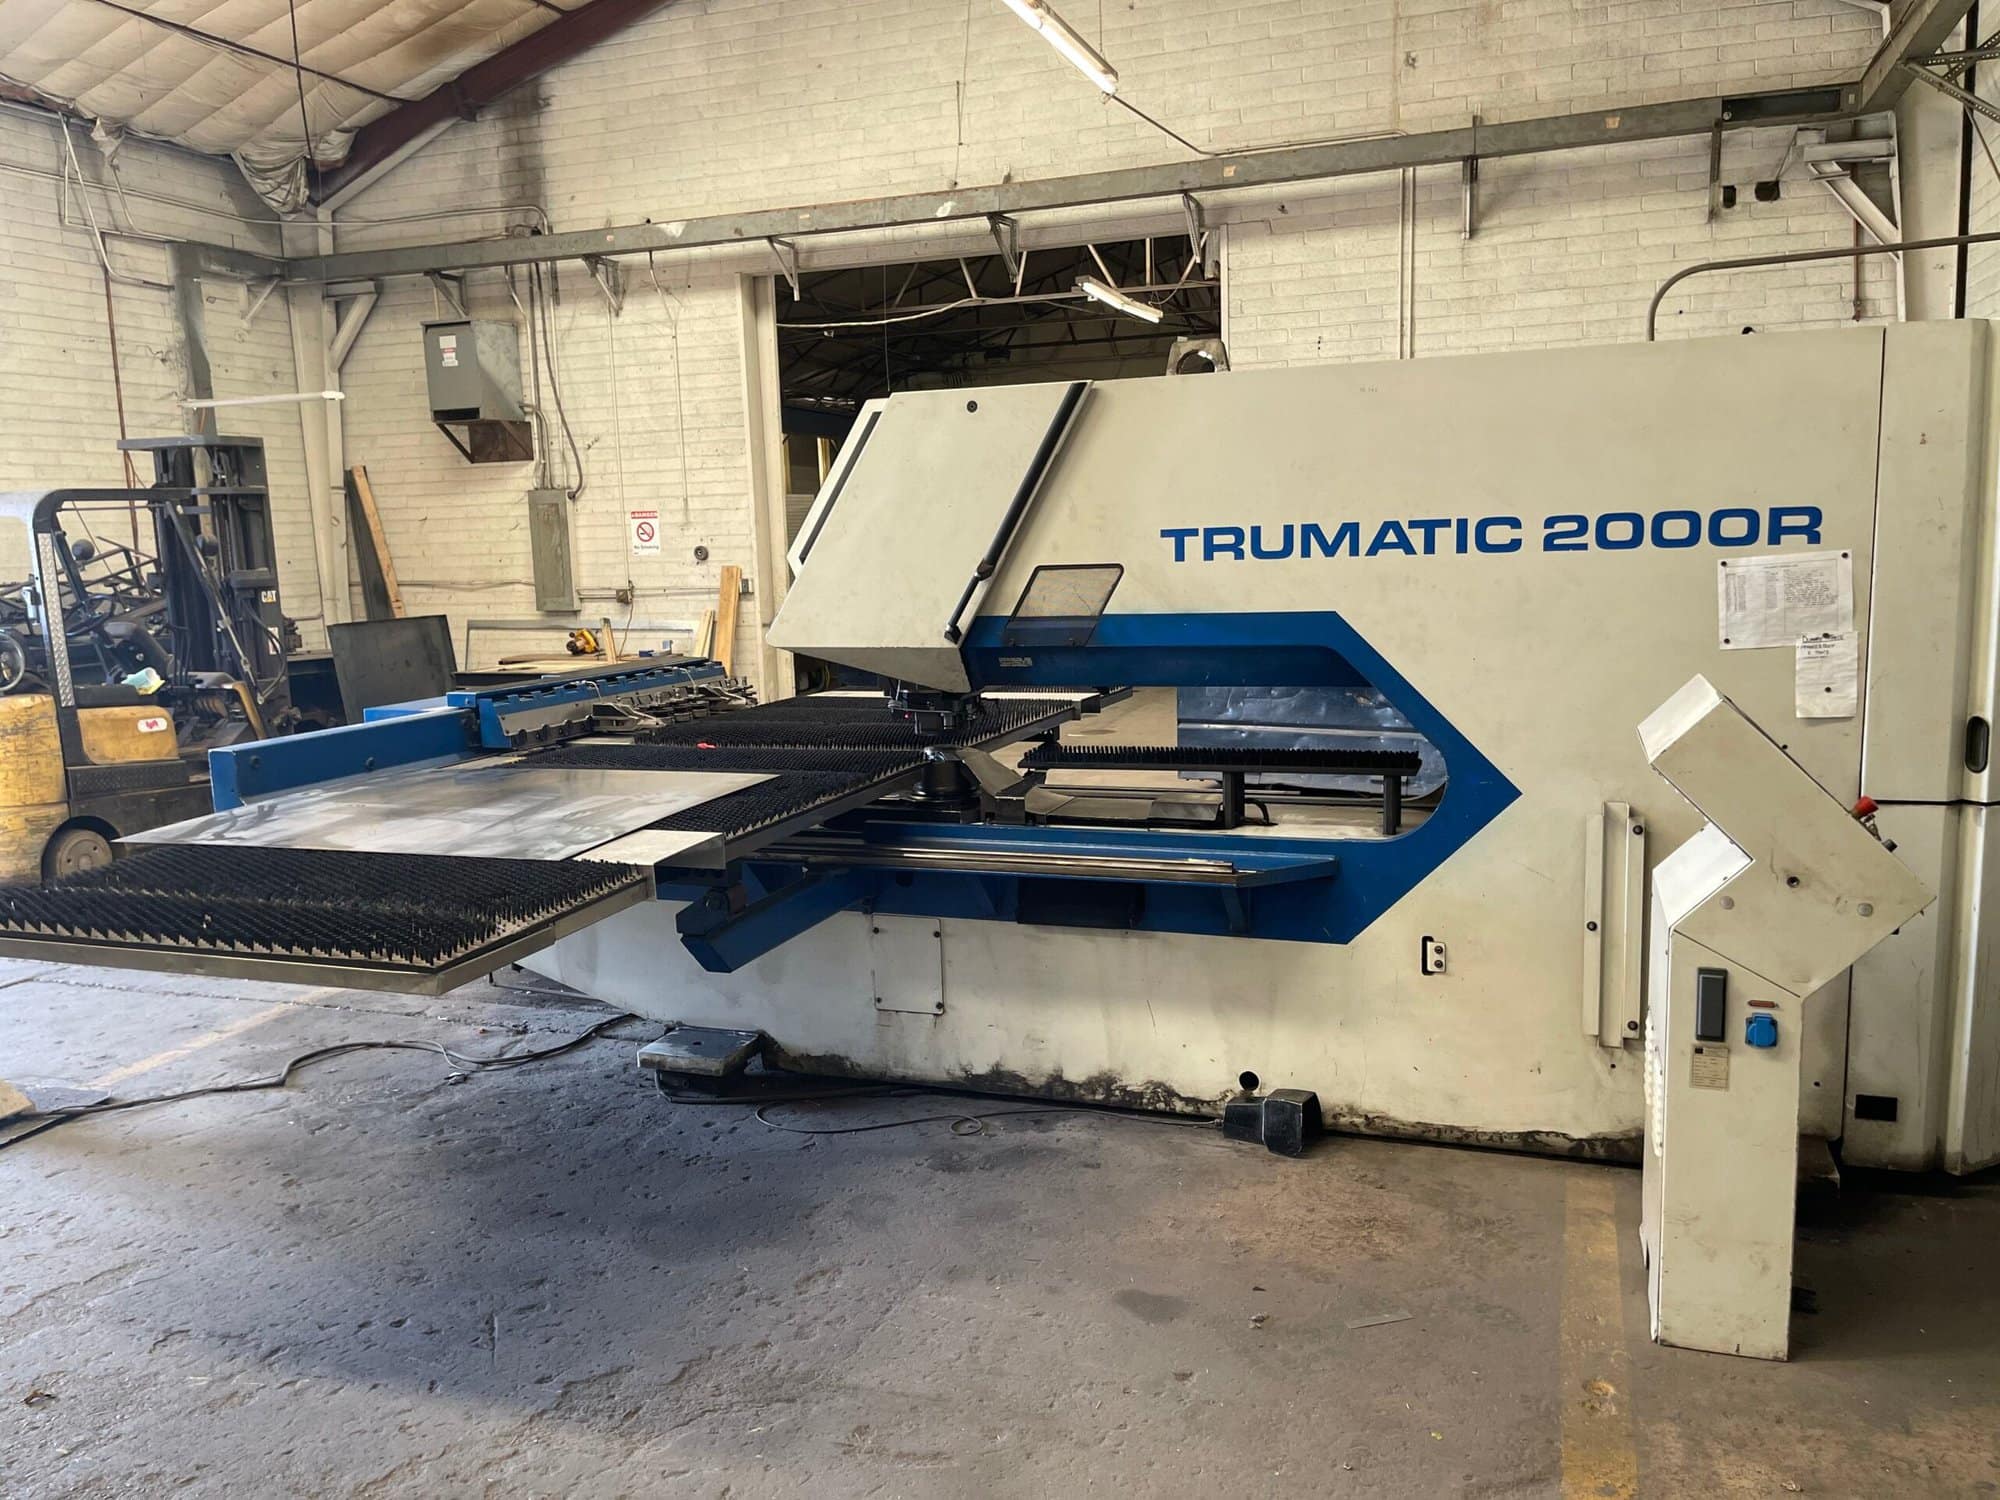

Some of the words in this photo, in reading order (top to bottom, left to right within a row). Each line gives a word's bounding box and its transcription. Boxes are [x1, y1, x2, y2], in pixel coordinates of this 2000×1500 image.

[1160, 516, 1523, 563] TRUMATIC
[1543, 506, 1823, 552] 2000R
[261, 590, 277, 603] CAT
